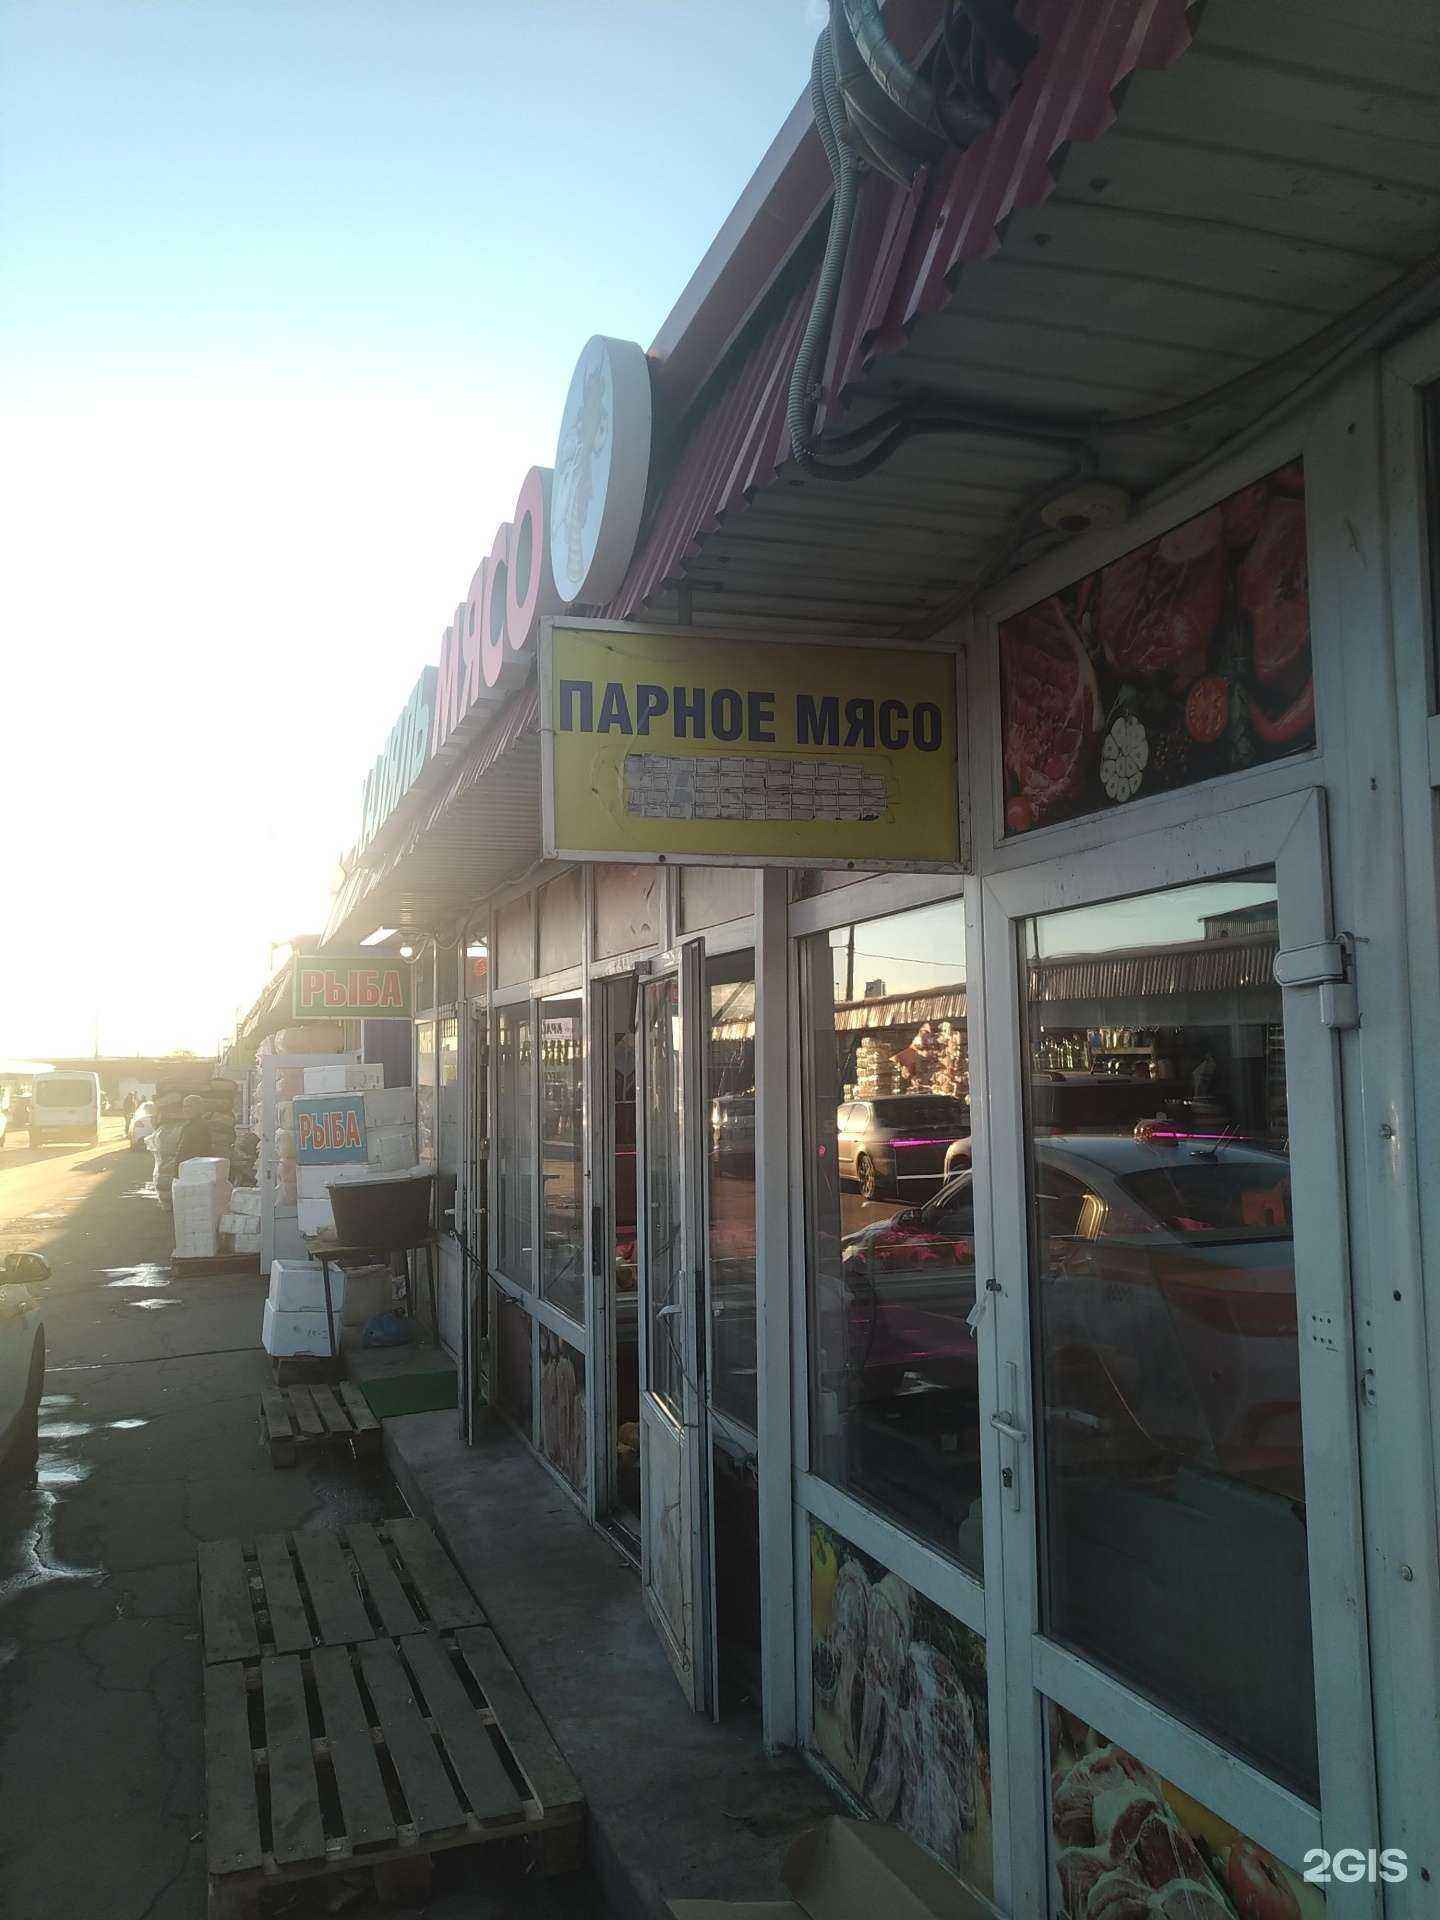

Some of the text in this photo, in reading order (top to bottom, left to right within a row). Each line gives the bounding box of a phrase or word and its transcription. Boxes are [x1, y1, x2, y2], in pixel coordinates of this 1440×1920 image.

[431, 465, 544, 759] МЯСО
[559, 679, 943, 752] ПАРНОЕ МЯСО
[300, 970, 403, 1007] РЫБА
[299, 1110, 362, 1151] РЫБА
